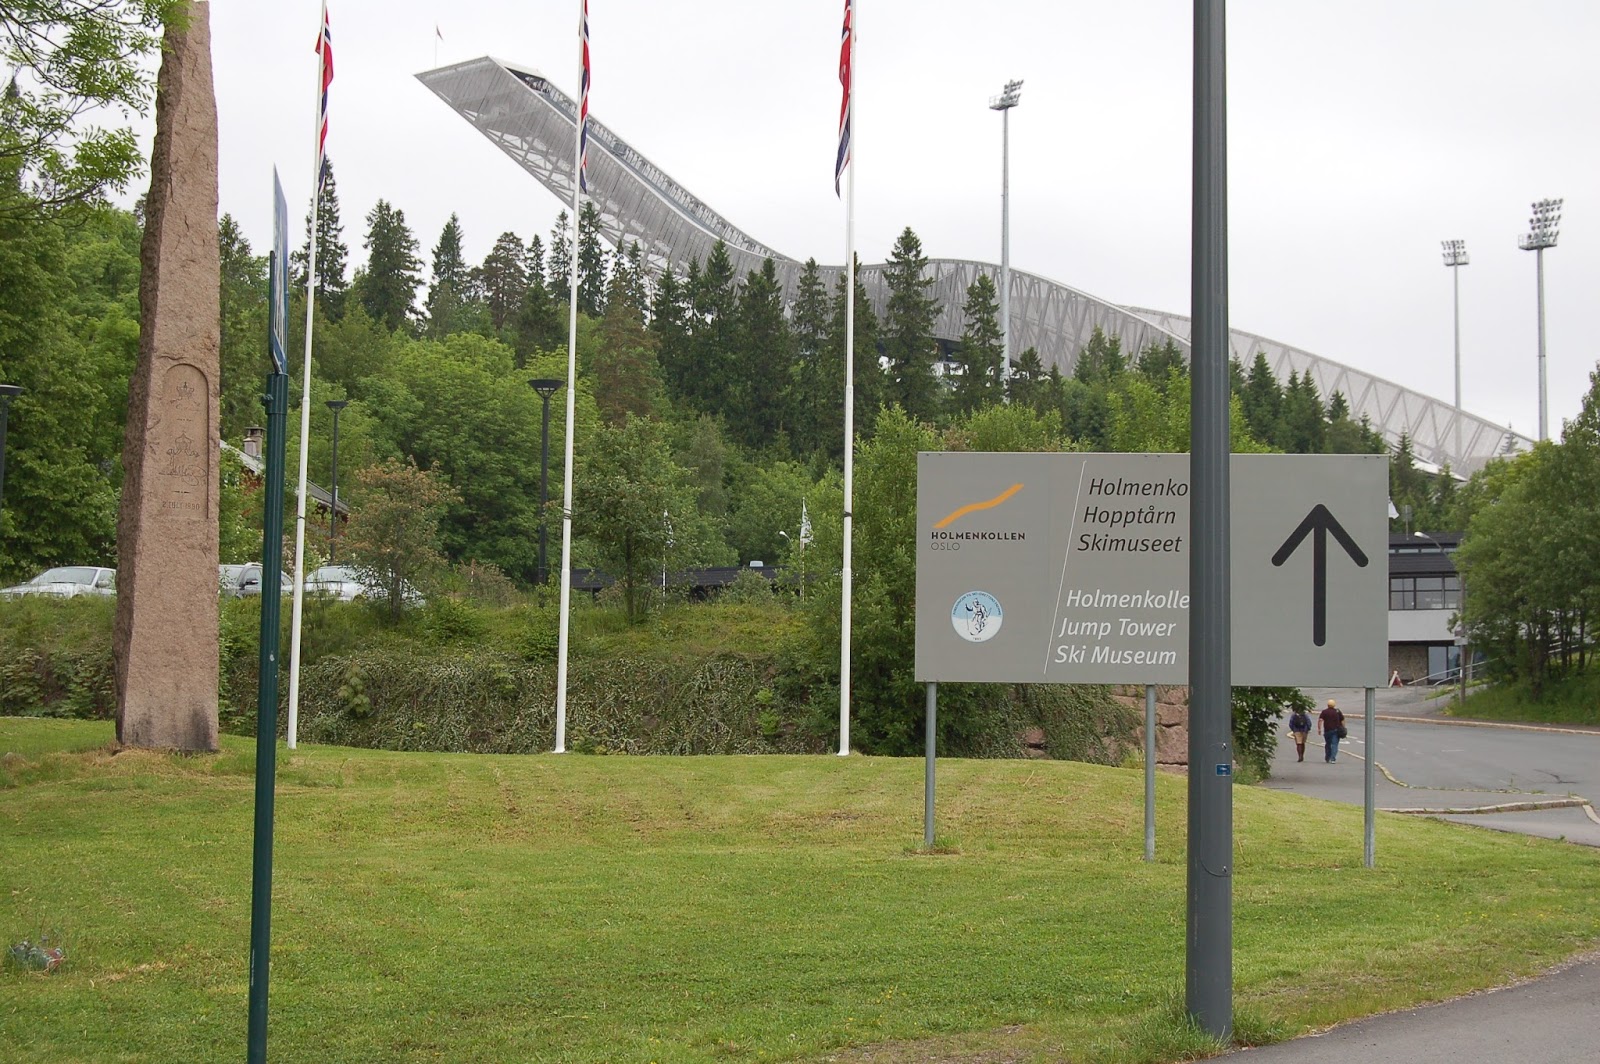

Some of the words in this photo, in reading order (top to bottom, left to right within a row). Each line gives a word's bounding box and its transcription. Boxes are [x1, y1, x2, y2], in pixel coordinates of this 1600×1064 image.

[1083, 505, 1176, 528] Hopptårn
[931, 531, 1025, 540] HOLMENKOLLEN
[1077, 533, 1182, 552] Skimuseet
[931, 542, 960, 550] OSLO
[1058, 617, 1112, 640] Jump
[1118, 618, 1177, 637] Tower
[1054, 645, 1087, 664] Ski
[1090, 646, 1177, 665] Museum
